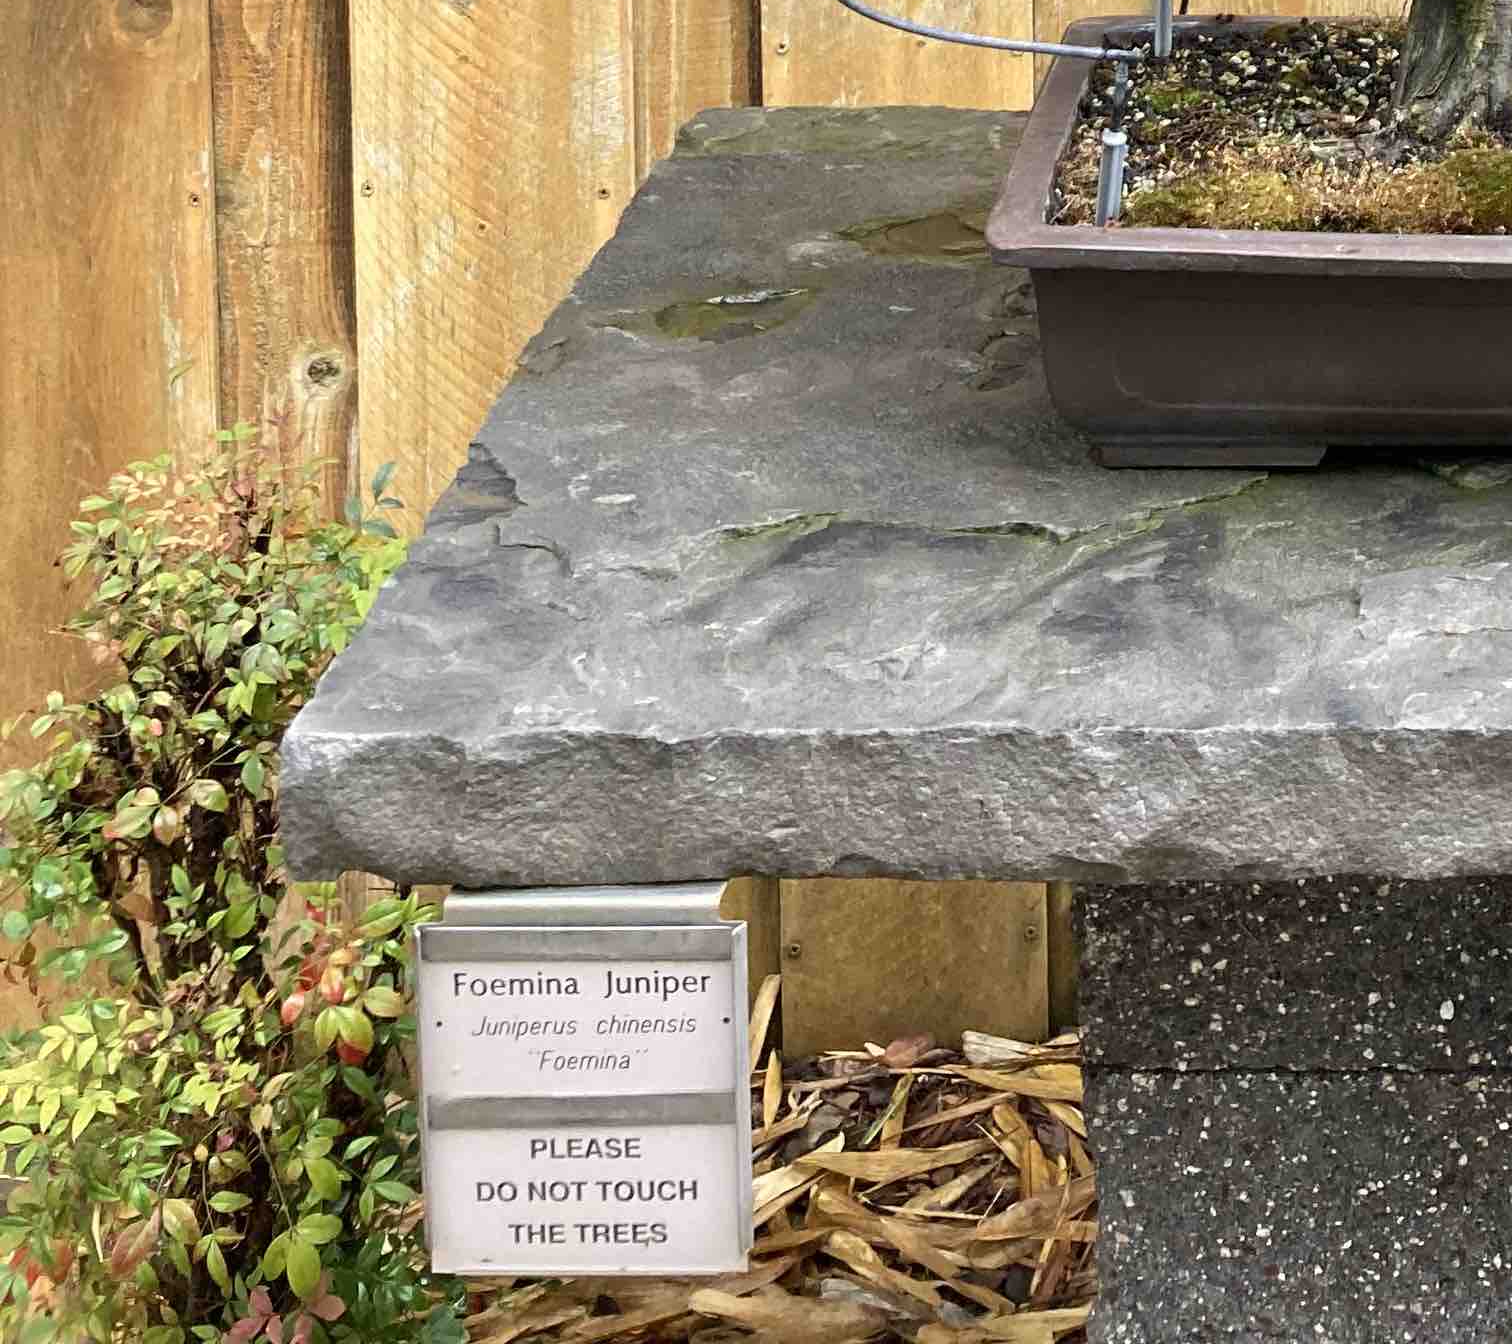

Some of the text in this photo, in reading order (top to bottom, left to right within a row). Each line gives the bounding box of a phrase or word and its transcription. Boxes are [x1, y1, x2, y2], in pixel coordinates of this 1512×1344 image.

[453, 970, 711, 1001] Foemina Juniper
[471, 1014, 697, 1040] Juniperus chinensis
[530, 1137, 642, 1160] PLEASE
[476, 1179, 698, 1202] DO NOT TOUCH
[508, 1223, 668, 1244] THE TREES
